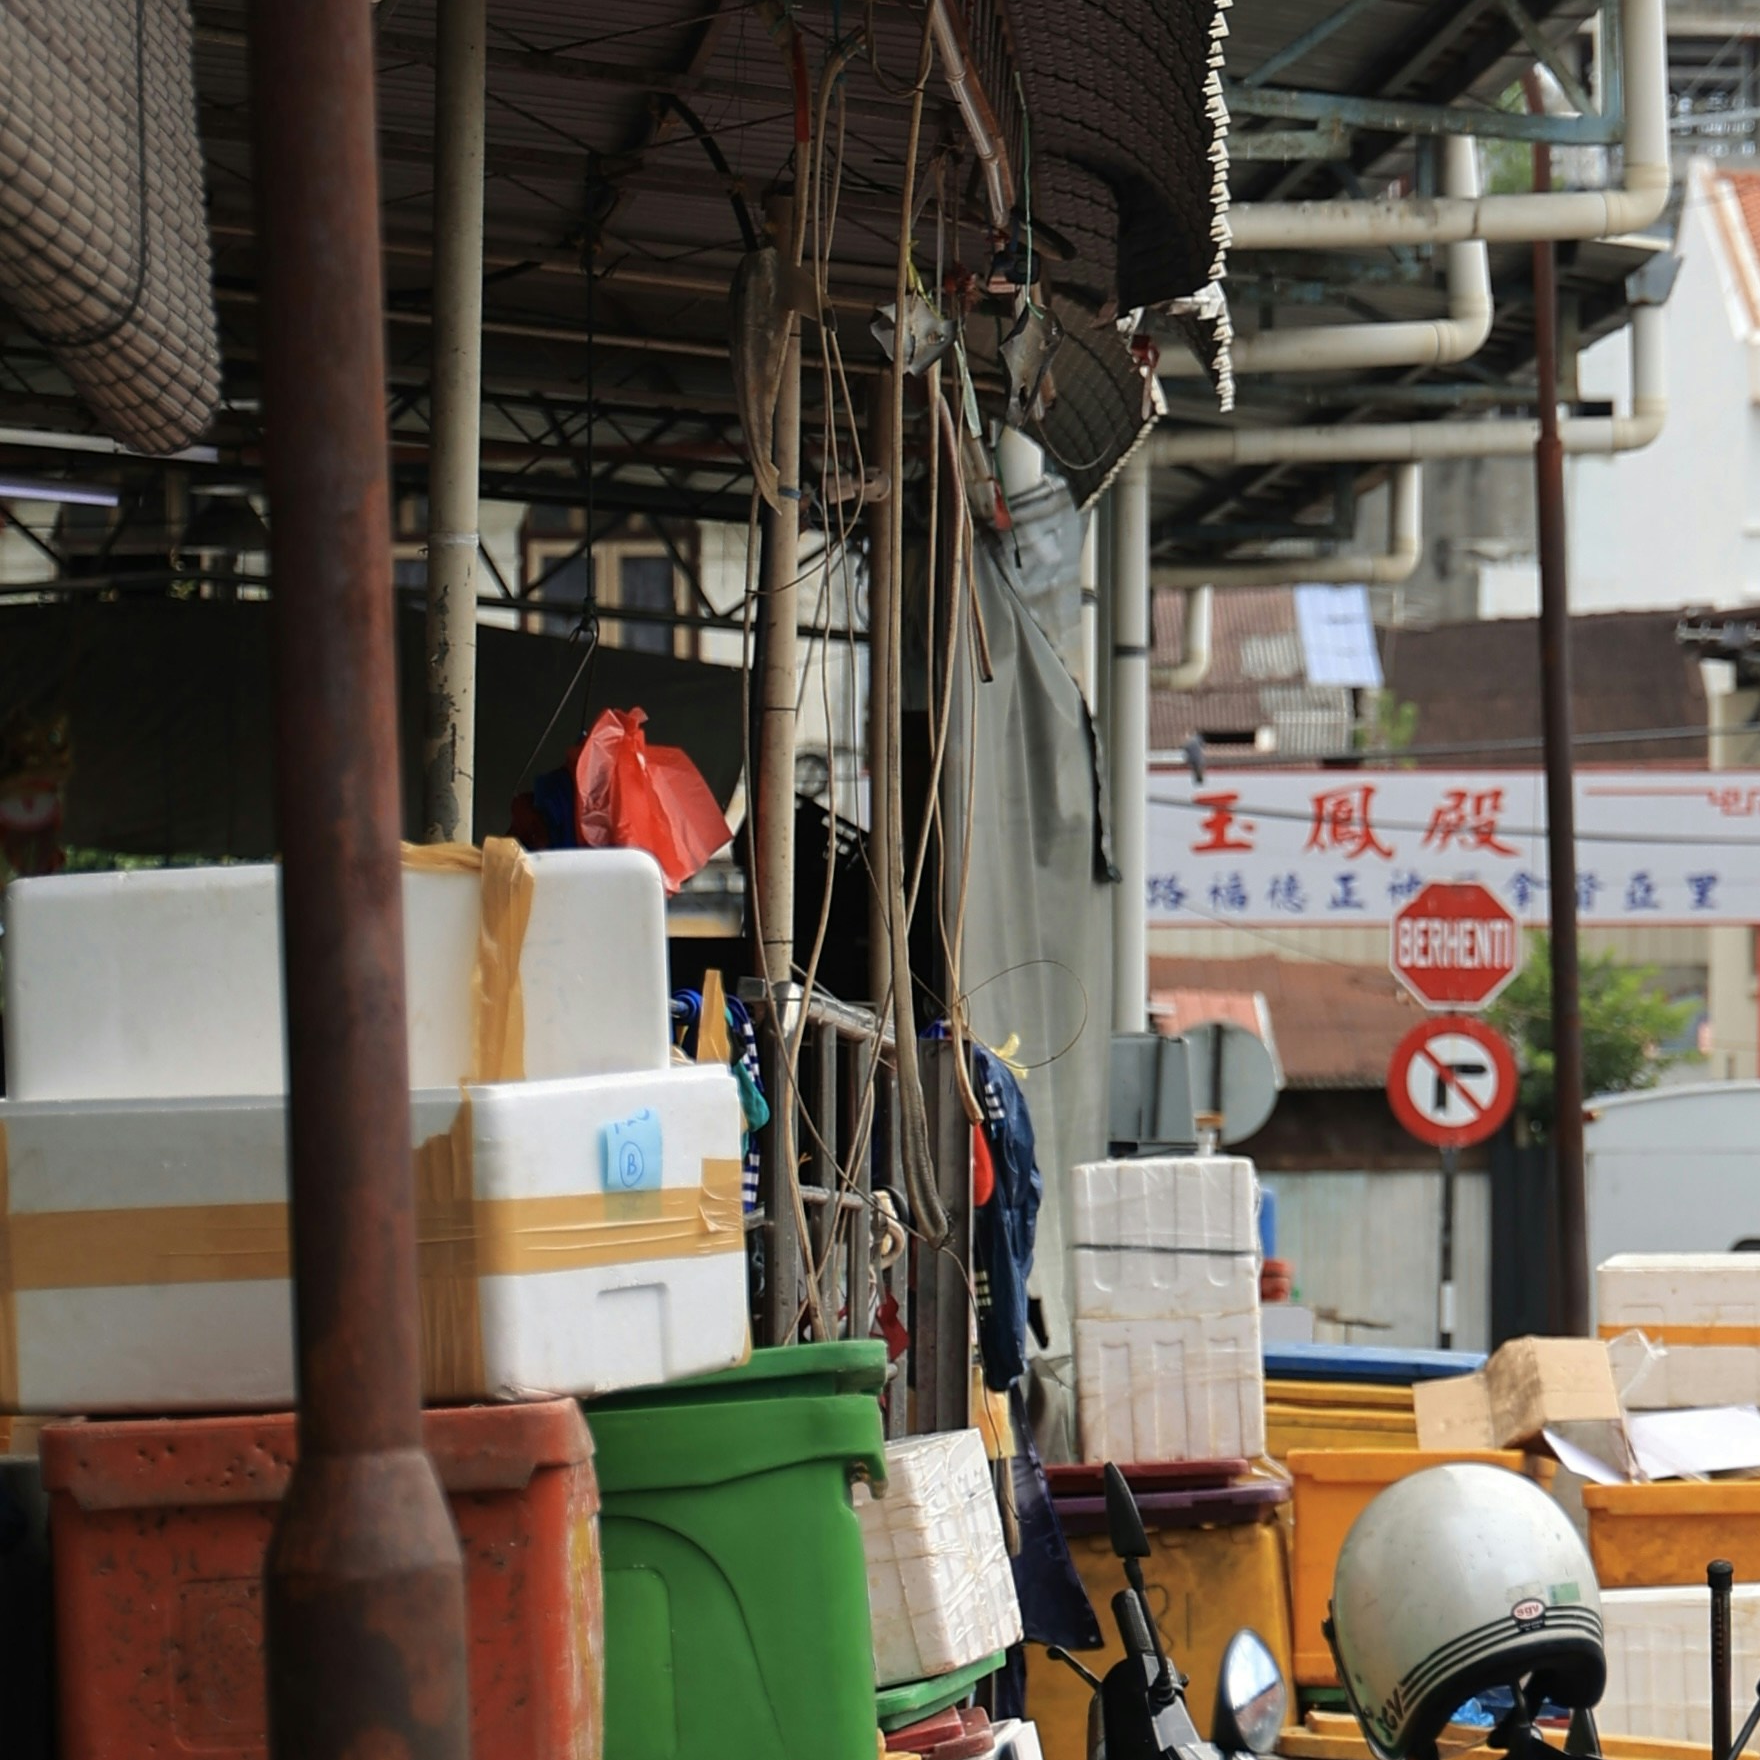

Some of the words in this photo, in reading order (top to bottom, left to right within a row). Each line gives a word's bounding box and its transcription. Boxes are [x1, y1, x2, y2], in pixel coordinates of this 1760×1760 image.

[1191, 783, 1521, 860] 玉鳳殿
[1397, 916, 1512, 970] BERHENTI
[626, 1153, 637, 1177] B
